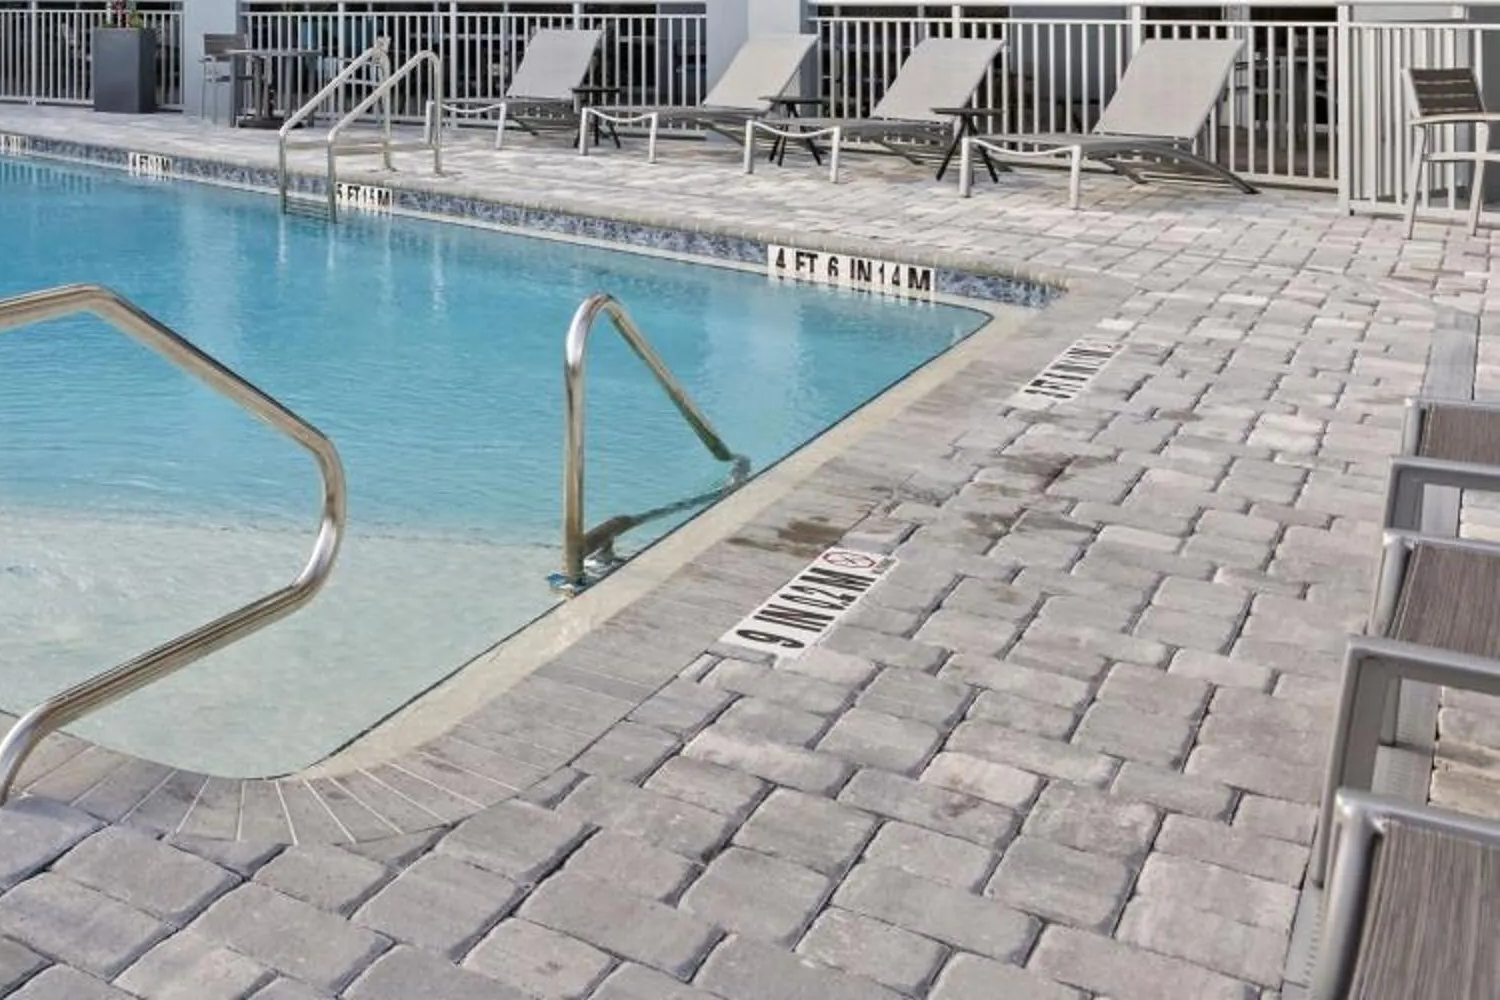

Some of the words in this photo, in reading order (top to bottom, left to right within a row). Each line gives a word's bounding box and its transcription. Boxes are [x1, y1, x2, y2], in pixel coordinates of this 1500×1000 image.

[776, 248, 786, 269] 4
[795, 251, 818, 273] FT
[827, 256, 839, 277] 6
[850, 258, 872, 282] IN
[754, 603, 835, 632] IN
[736, 629, 804, 648] 9
